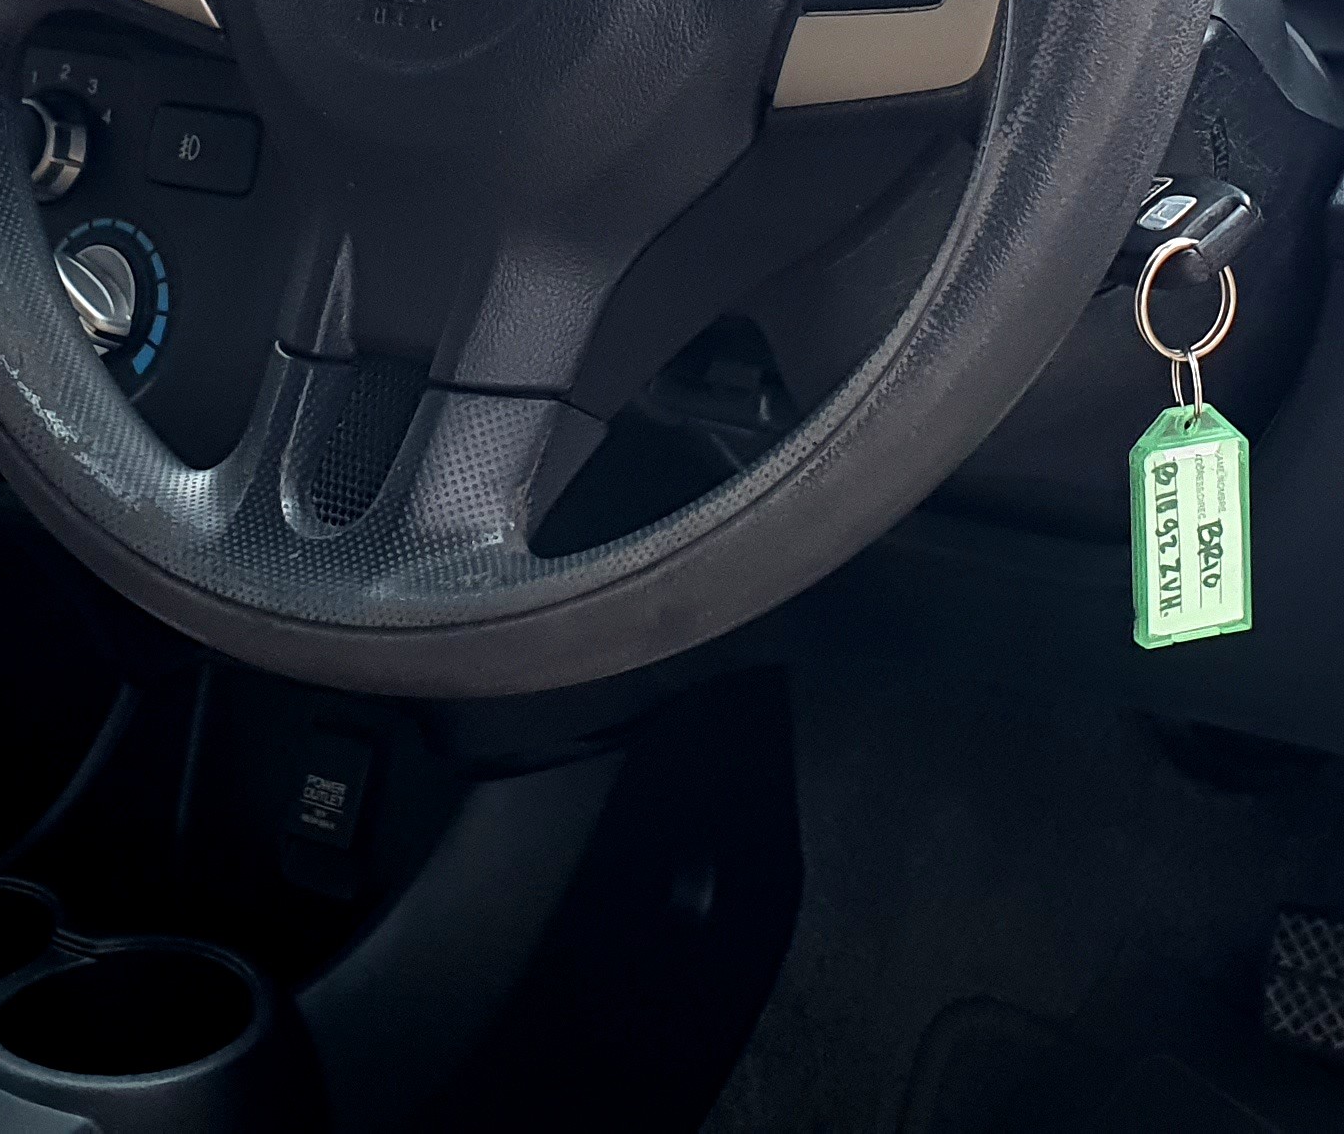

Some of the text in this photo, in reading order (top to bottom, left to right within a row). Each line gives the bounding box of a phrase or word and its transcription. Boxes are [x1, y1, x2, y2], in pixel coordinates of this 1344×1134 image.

[60, 63, 71, 81] 2
[87, 78, 98, 95] 3
[1151, 461, 1178, 485] B
[1197, 519, 1224, 589] BRIO
